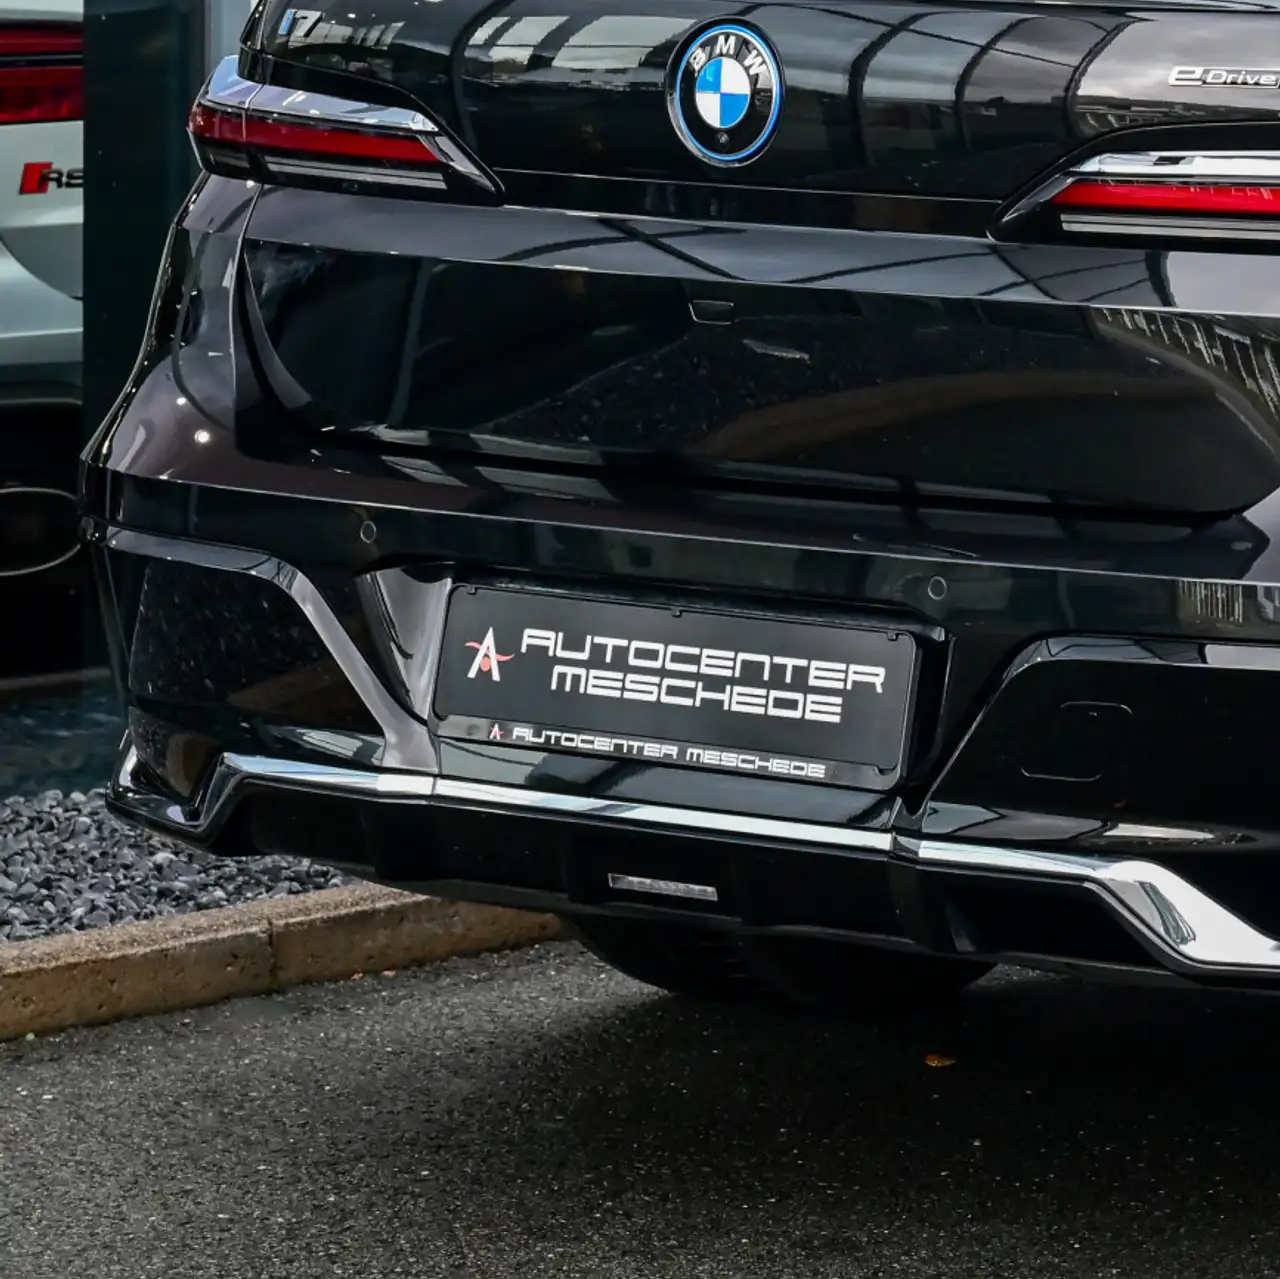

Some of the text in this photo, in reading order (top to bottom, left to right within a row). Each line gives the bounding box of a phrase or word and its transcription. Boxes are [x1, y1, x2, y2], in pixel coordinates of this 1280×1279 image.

[688, 34, 768, 77] BMW
[520, 627, 887, 694] AUTOCENTER
[550, 665, 844, 724] MESCHEDE
[512, 726, 827, 779] AUTOCENTER MESCHEDE
